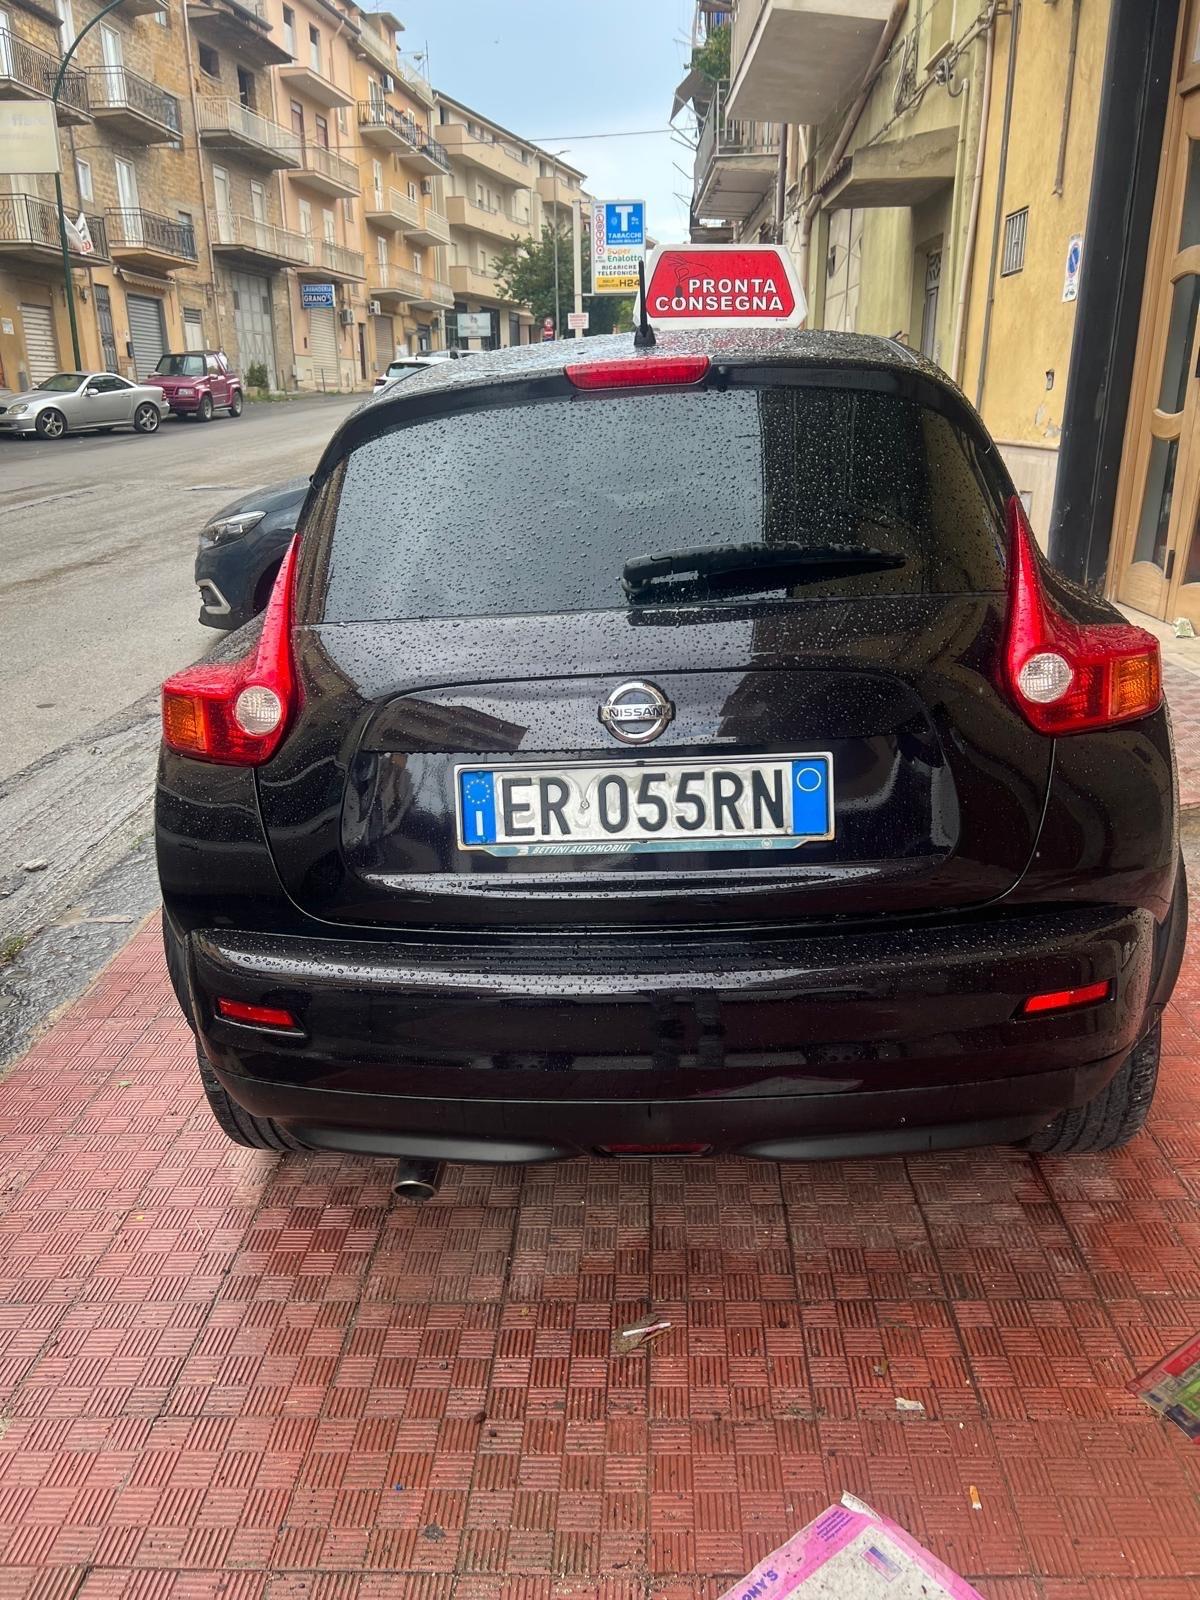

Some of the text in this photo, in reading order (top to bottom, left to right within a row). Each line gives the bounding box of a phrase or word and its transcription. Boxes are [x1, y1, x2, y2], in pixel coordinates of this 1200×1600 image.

[615, 205, 634, 232] T
[688, 278, 777, 294] PRONTA
[655, 296, 784, 311] CONSEGNA
[609, 706, 663, 718] NISSAN
[532, 843, 632, 854] BETTINI AUTOMOBILI
